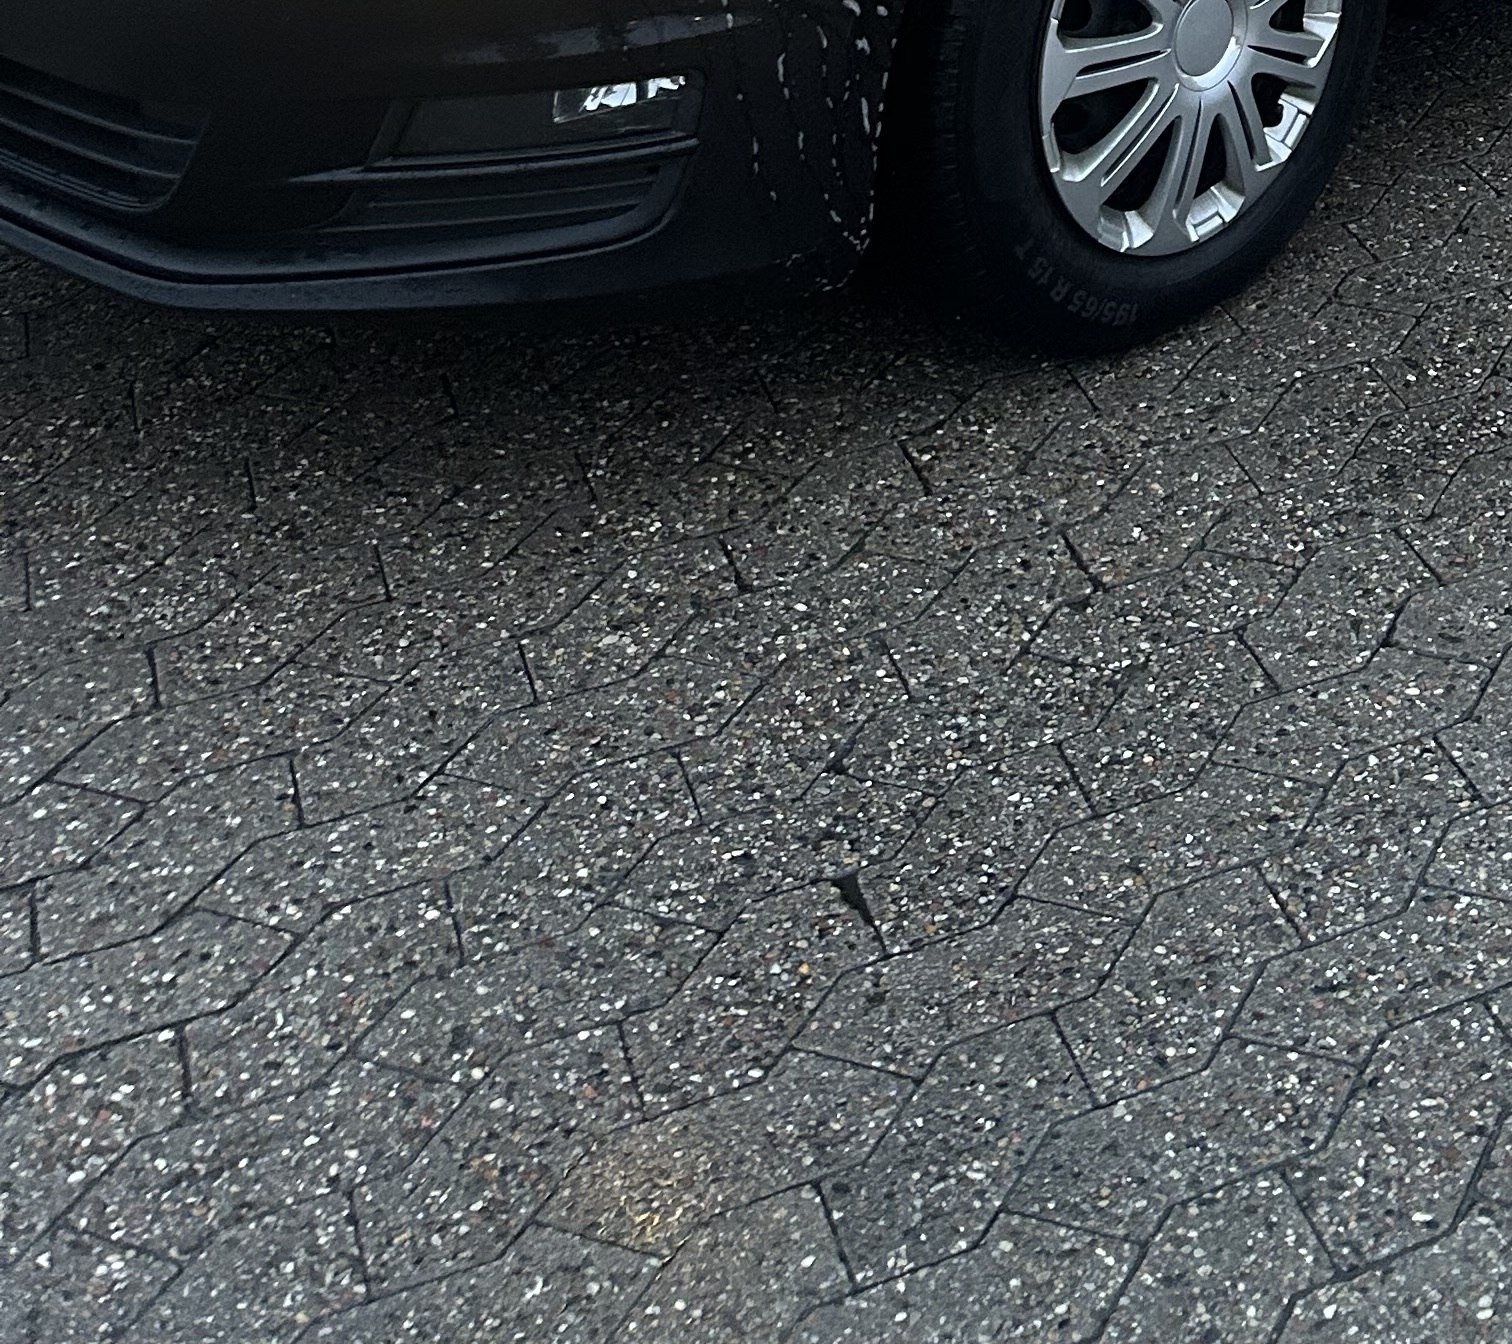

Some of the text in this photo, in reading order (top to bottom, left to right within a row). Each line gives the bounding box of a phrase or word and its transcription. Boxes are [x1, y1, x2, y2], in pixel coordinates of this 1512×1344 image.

[1027, 257, 1055, 286] 15
[1049, 275, 1074, 303] R
[1067, 289, 1138, 325] 195/65
